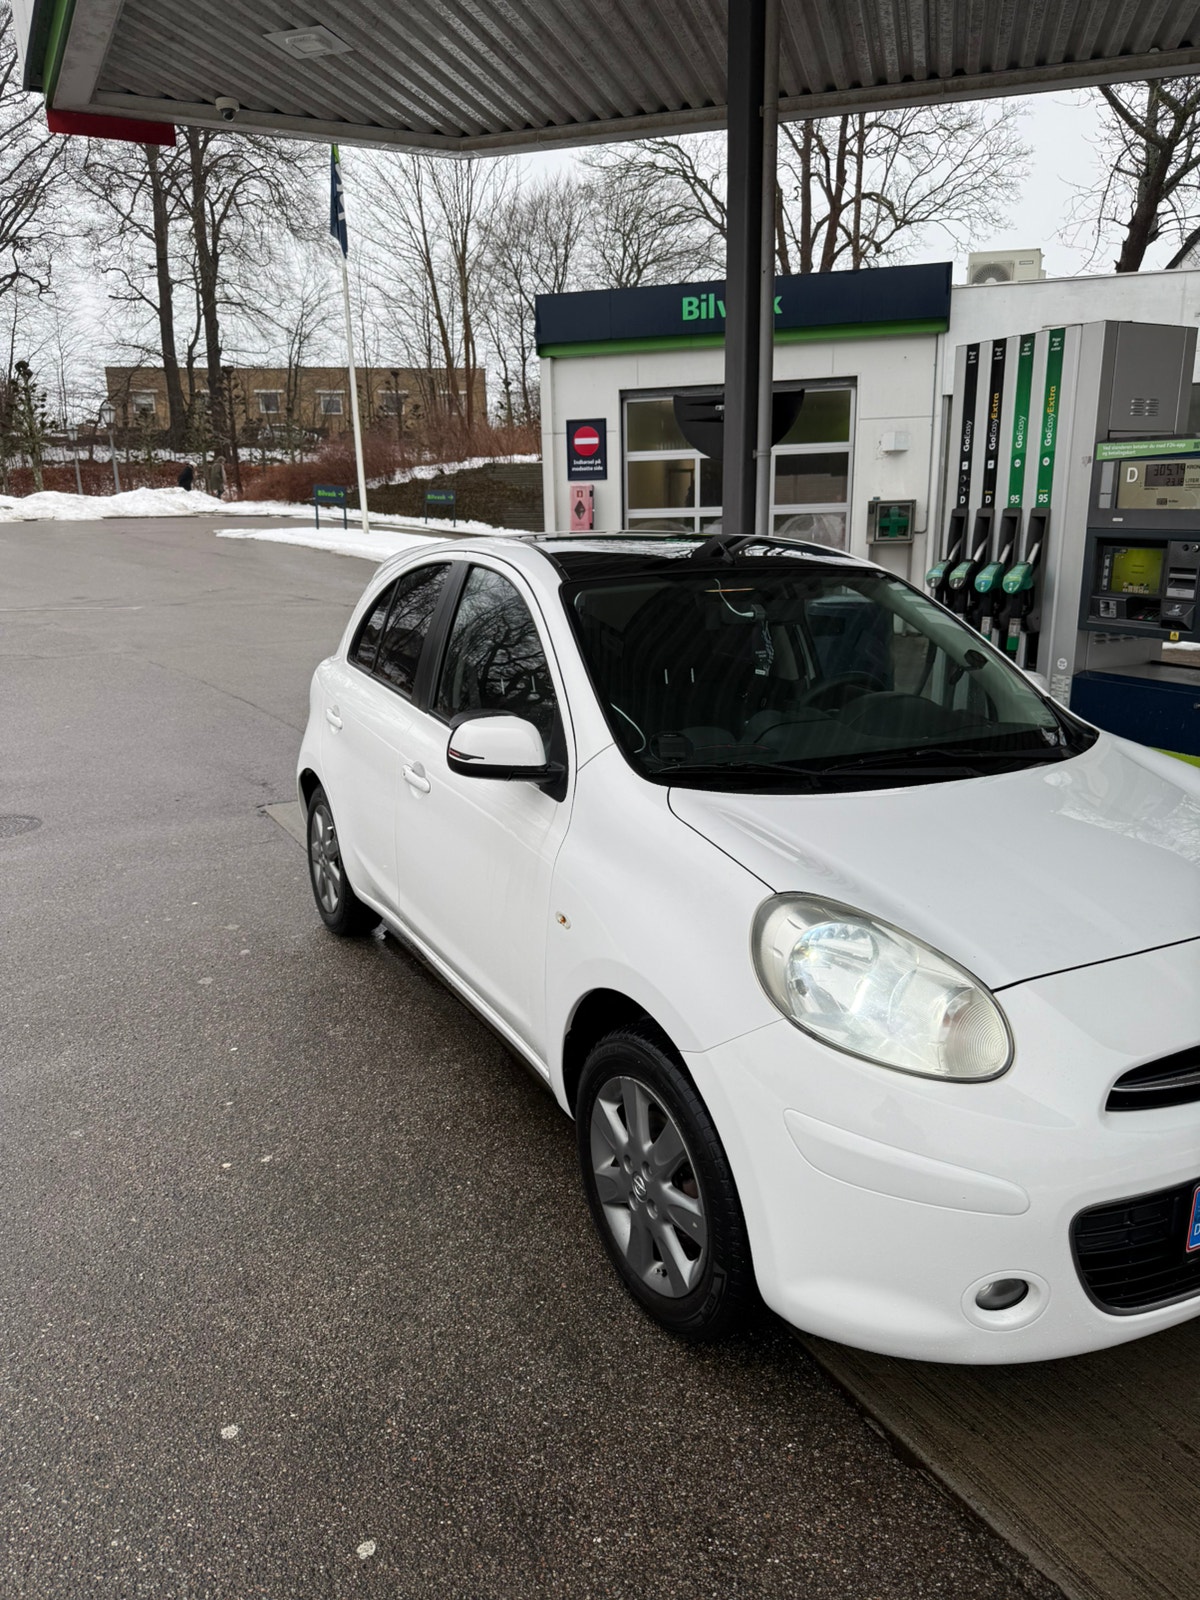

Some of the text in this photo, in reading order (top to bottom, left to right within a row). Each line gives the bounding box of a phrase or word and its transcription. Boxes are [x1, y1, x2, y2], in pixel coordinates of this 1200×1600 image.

[682, 293, 783, 321] Bilvk
[963, 420, 973, 451] GoEasy
[1015, 415, 1027, 448] GoEasy
[1126, 467, 1138, 483] D
[1010, 494, 1020, 503] 95
[1038, 494, 1048, 503] 95
